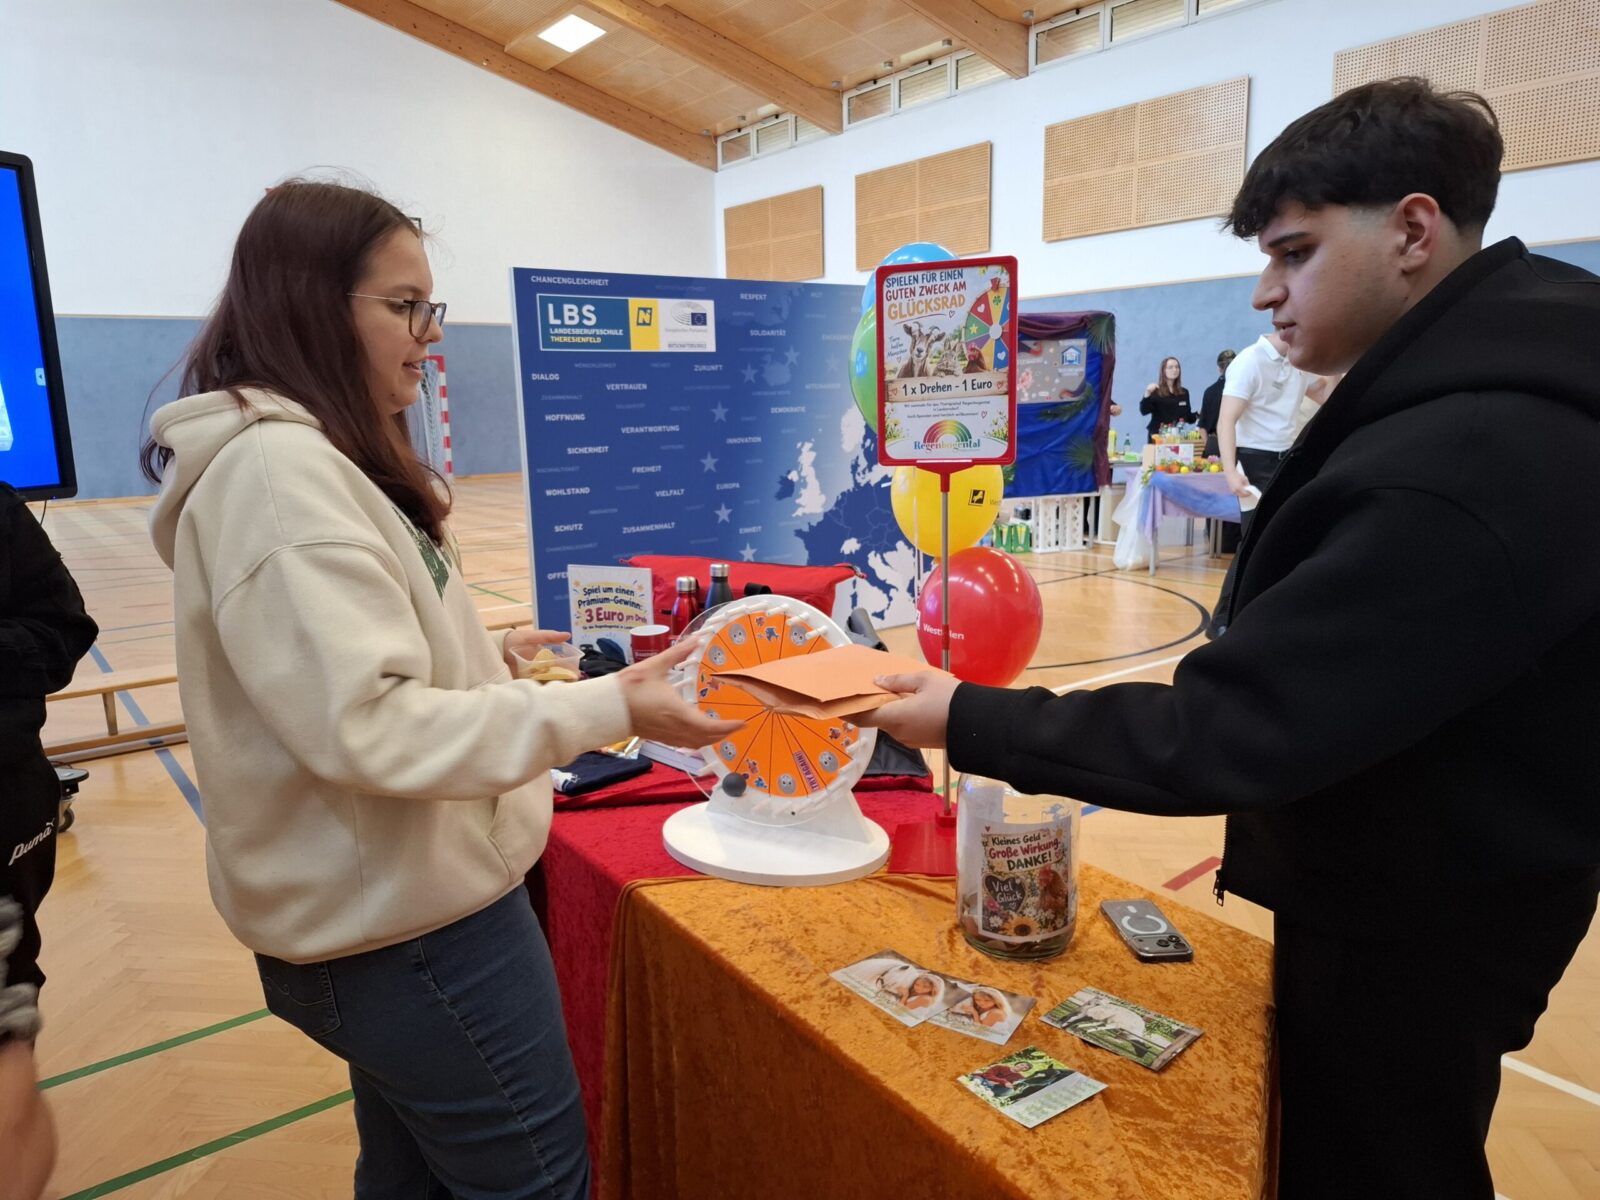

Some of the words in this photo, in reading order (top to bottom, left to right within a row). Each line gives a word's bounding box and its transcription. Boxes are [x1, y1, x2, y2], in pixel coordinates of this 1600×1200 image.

[530, 275, 609, 287] CHANCENGLEICHHEIT
[886, 273, 919, 289] SPIELEN
[921, 271, 937, 284] FÜR
[940, 268, 964, 282] EINEN
[740, 292, 767, 301] RESPEKT
[885, 287, 916, 302] GUTEN
[919, 282, 951, 297] ZWECK
[953, 280, 967, 293] AM
[887, 293, 966, 321] GLÜCKSRAD
[547, 303, 597, 326] LBS
[549, 327, 624, 336] LANDESBERUFSSCHULE
[749, 328, 787, 337] SOLIDARITÄT
[551, 336, 601, 344] THERESIENFELD
[693, 364, 724, 372] ZUKUNFT
[531, 373, 560, 381] DIALOG
[605, 383, 648, 391] VERTRAUEN
[902, 384, 908, 397] 1
[910, 386, 917, 395] x
[920, 381, 952, 395] Drehen
[962, 379, 967, 391] 1
[971, 379, 993, 391] Euro
[770, 406, 807, 415] DEMOKRATIE
[544, 413, 586, 422] HOFFNUNG
[620, 424, 680, 435] VERANTWORTUNG
[726, 436, 762, 445] INNOVATION
[914, 438, 981, 452] Regenbogental
[566, 445, 609, 455] SICHERHEIT
[631, 465, 662, 474] FREIHEIT
[545, 486, 591, 497] WOHLSTAND
[715, 481, 741, 491] EUROPA
[654, 488, 686, 498] VIELFALT
[553, 522, 584, 533] SCHUTZ
[622, 521, 676, 535] ZUSAMMENHALT
[739, 525, 763, 536] EINHEIT
[583, 585, 601, 596] Spiel
[615, 586, 635, 597] einen
[585, 608, 594, 623] 3
[595, 606, 624, 622] Euro
[991, 836, 1021, 847] Kleines
[1022, 834, 1041, 844] Geld
[988, 846, 1019, 860] Große
[1006, 850, 1052, 871] DANKE!
[991, 880, 1013, 893] Viel
[996, 891, 1023, 904] Glück
